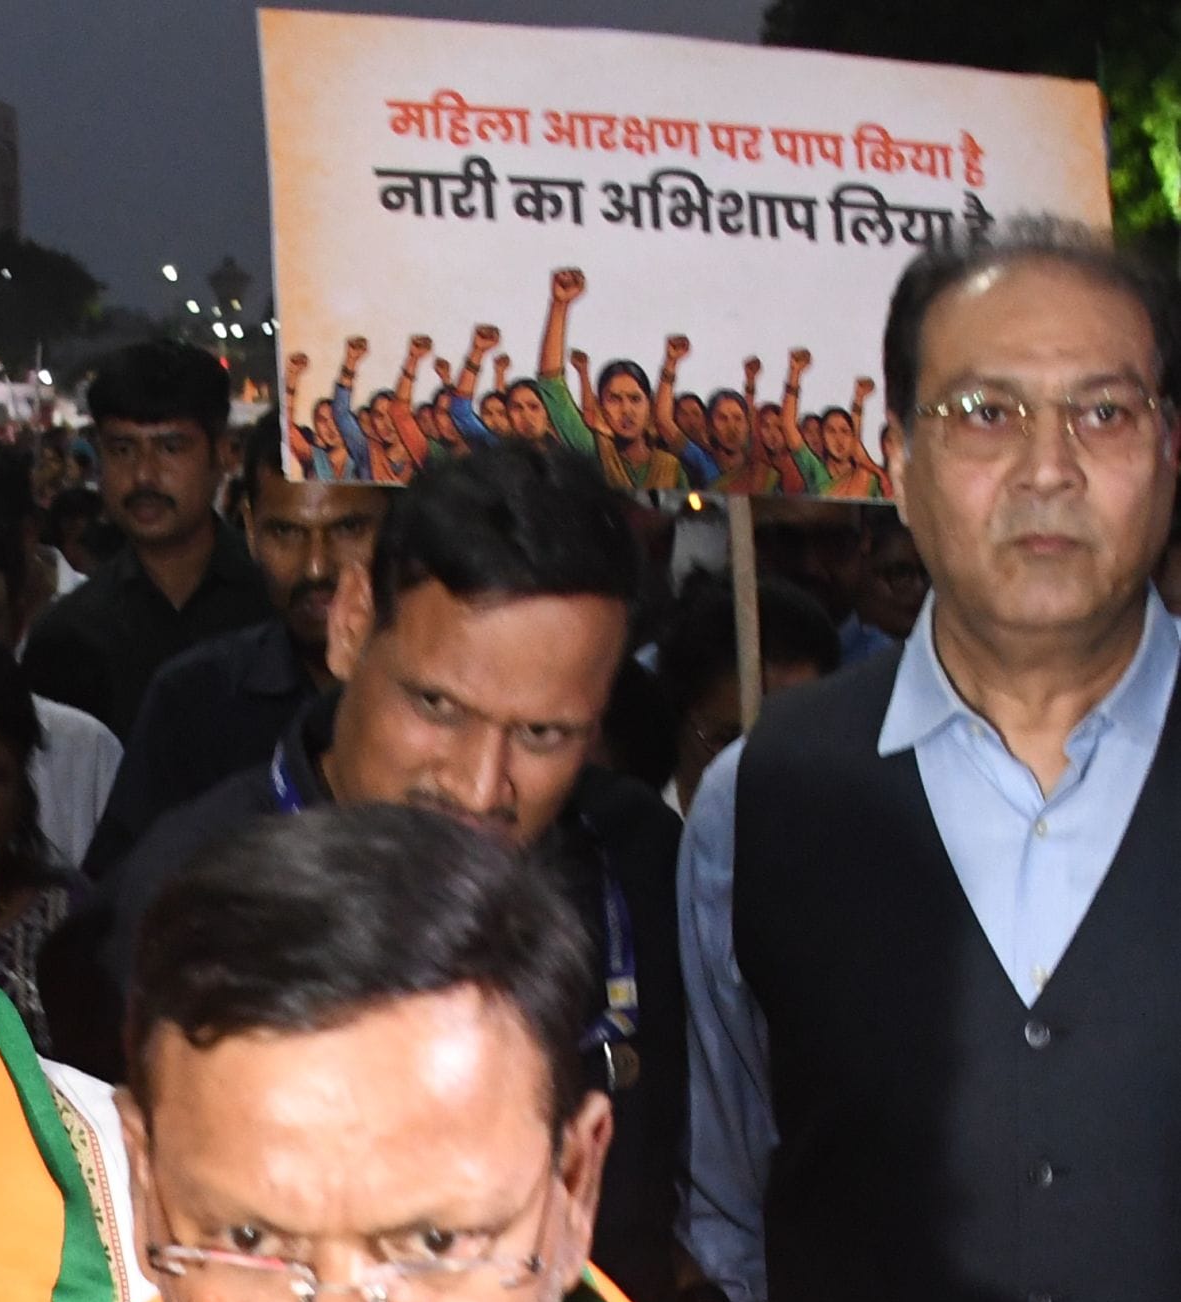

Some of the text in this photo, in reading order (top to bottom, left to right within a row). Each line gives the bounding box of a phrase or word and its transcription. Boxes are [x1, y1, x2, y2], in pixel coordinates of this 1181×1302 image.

[385, 88, 986, 188] महिला आरक्षण पर पाप किया है
[373, 153, 499, 222] नारी
[507, 174, 586, 226] का
[599, 166, 819, 243] अभिशाप
[826, 182, 955, 252] लिया
